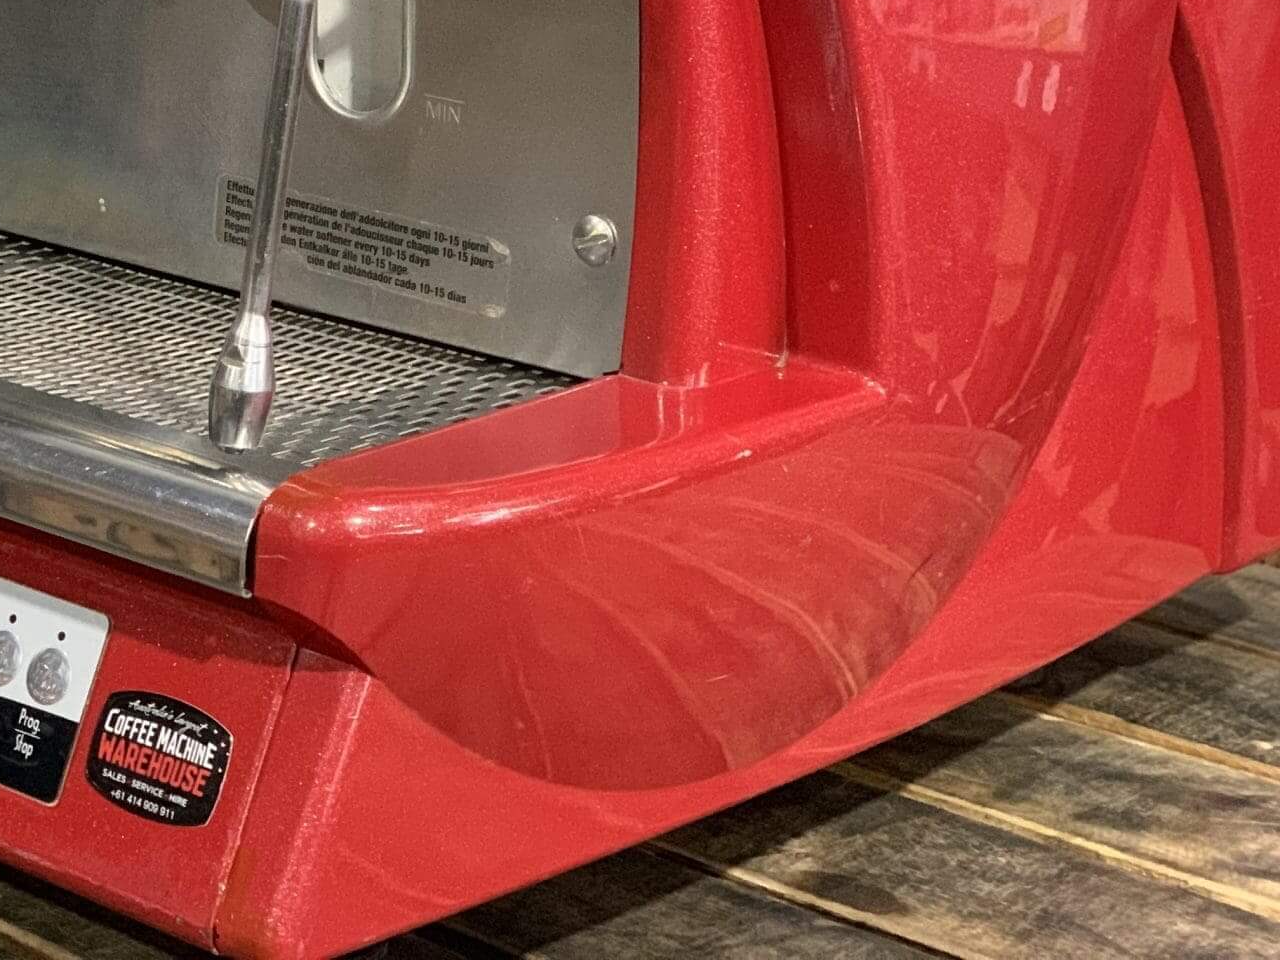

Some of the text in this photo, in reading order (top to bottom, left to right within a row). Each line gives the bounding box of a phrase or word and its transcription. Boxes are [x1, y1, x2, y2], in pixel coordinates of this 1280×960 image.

[425, 100, 461, 124] MIN
[226, 179, 255, 196] Effettu
[410, 227, 431, 240] ogni
[433, 230, 460, 246] 10-15
[461, 239, 490, 253] giorni
[289, 224, 314, 237] water
[354, 240, 378, 256] every
[381, 245, 407, 261] 10-15
[408, 253, 431, 268] days
[406, 240, 440, 256] chaque
[442, 247, 469, 262] 10-15
[470, 255, 495, 269] jours
[361, 253, 386, 269] 10-15
[394, 278, 417, 292] cada
[419, 282, 446, 298] 10-15
[18, 707, 41, 736] Prog.
[128, 699, 175, 721] Australia's
[13, 733, 34, 760] Stop
[103, 707, 218, 770] COFFEE MACHINE
[98, 731, 212, 798] WAREHOUSE
[102, 767, 189, 808] SALES SERVICE HIRE
[110, 789, 125, 801] +61
[126, 793, 141, 807] 414
[159, 805, 175, 820] 911
